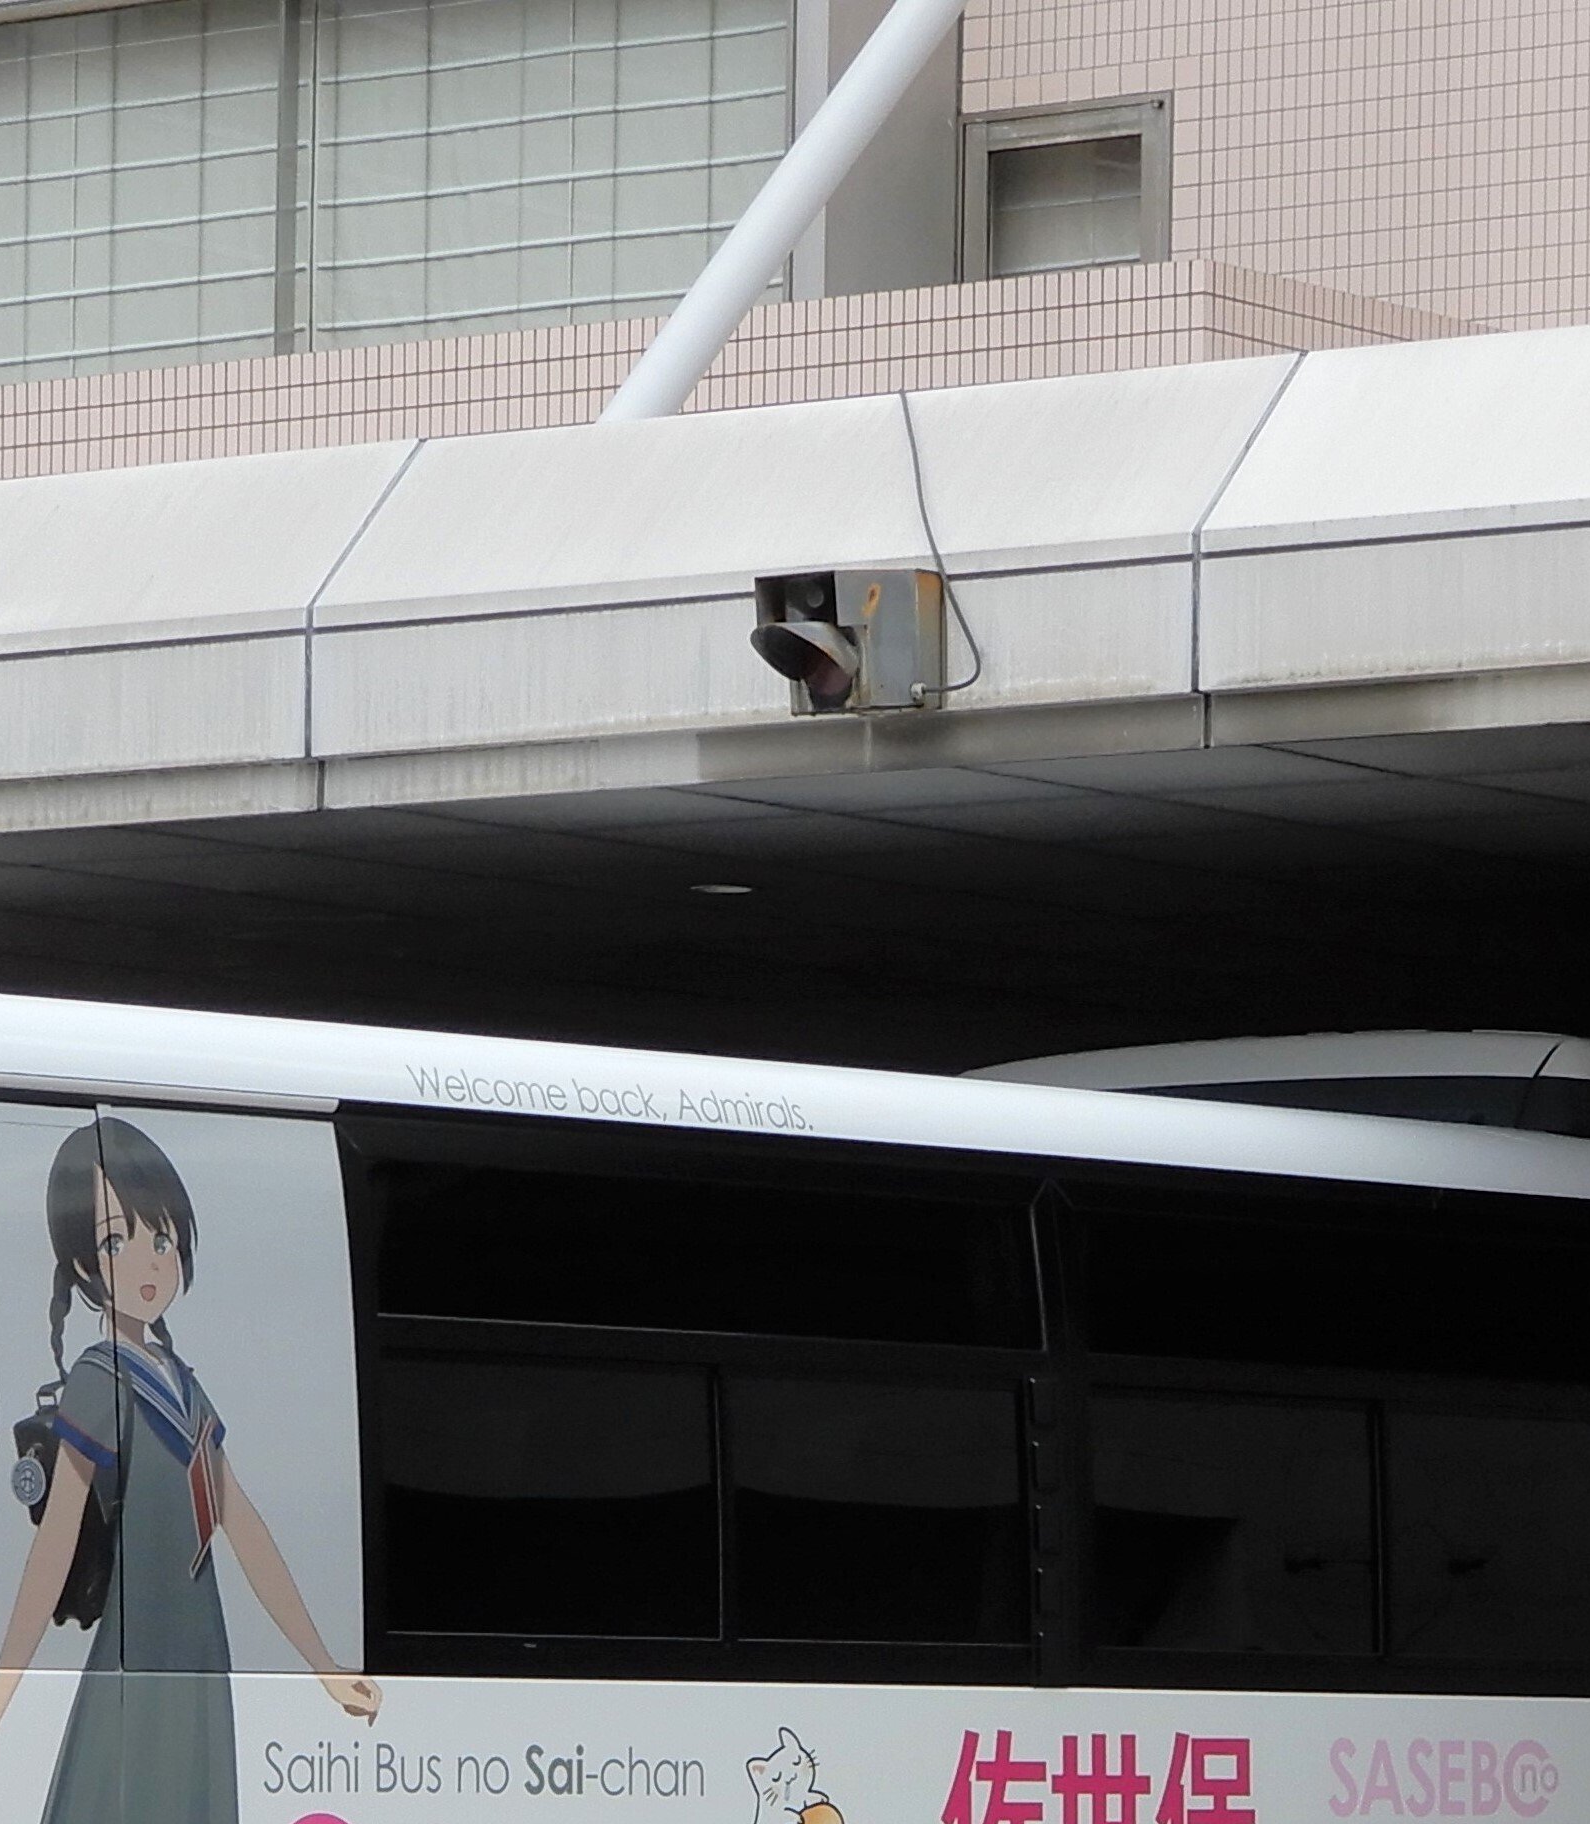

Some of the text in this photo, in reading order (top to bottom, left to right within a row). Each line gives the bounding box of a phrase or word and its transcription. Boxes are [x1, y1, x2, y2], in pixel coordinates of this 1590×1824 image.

[406, 1064, 814, 1132] Welcome back, Admirals.
[263, 1741, 705, 1797] Saihi Bus no Sai-chan
